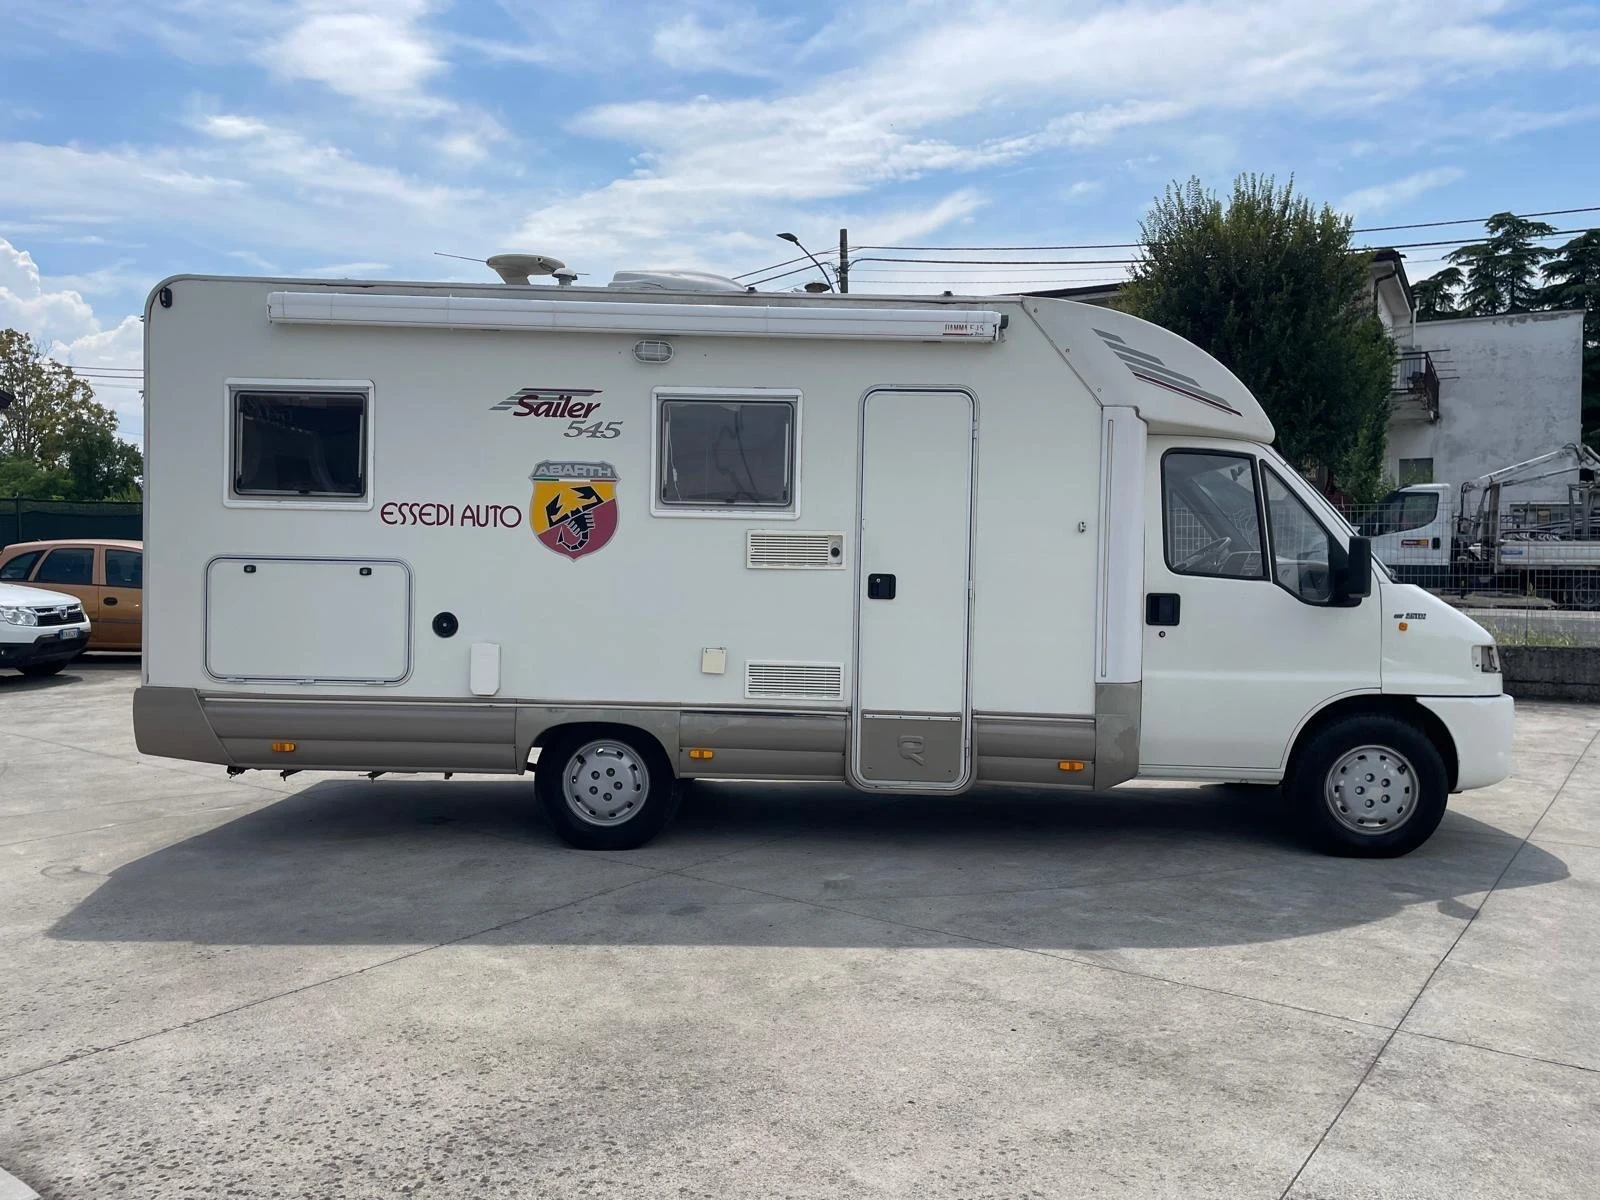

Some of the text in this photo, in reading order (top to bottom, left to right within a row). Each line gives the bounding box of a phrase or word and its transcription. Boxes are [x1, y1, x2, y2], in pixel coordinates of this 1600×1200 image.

[512, 394, 602, 419] Sailer
[563, 420, 624, 439] 545
[535, 464, 612, 477] ABARTH
[380, 502, 523, 528] ESSEDI AUTO
